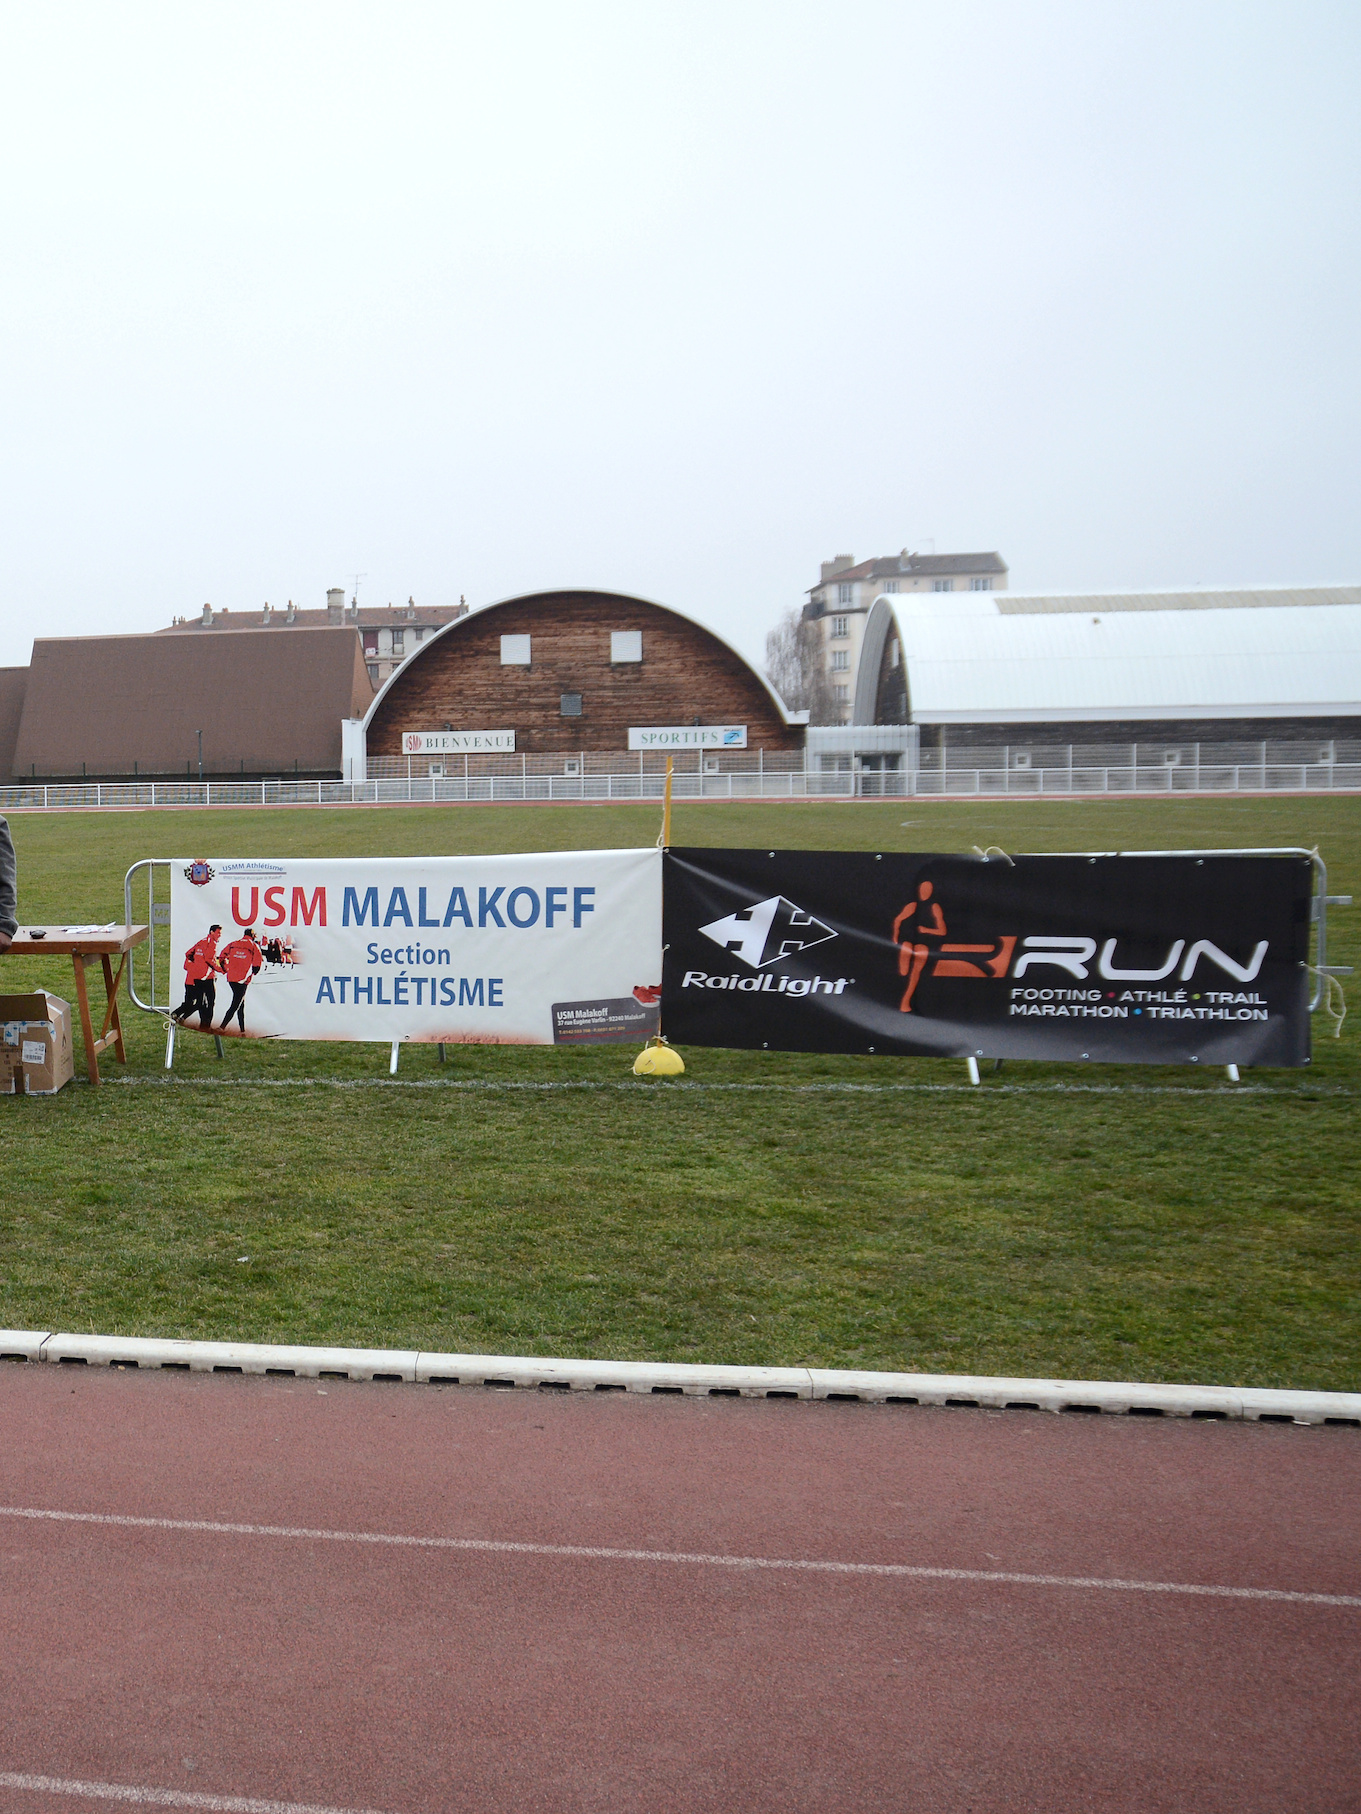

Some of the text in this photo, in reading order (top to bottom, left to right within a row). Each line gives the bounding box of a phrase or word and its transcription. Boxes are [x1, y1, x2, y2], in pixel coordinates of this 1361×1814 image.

[426, 736, 514, 748] BIENVENUE
[641, 731, 718, 744] SPORTIFS
[222, 862, 284, 872] USMM Athlétisme
[231, 886, 596, 929] USM MALAKOFF
[366, 942, 451, 966] Section
[315, 971, 504, 1007] ATHLÉTISME
[681, 970, 849, 998] RaidLight
[1010, 988, 1267, 1005] FOOTING ATHLÉ TRAIL
[556, 1007, 609, 1020] USM Malakoff
[1009, 1004, 1269, 1021] MARATHON TRIATHLON
